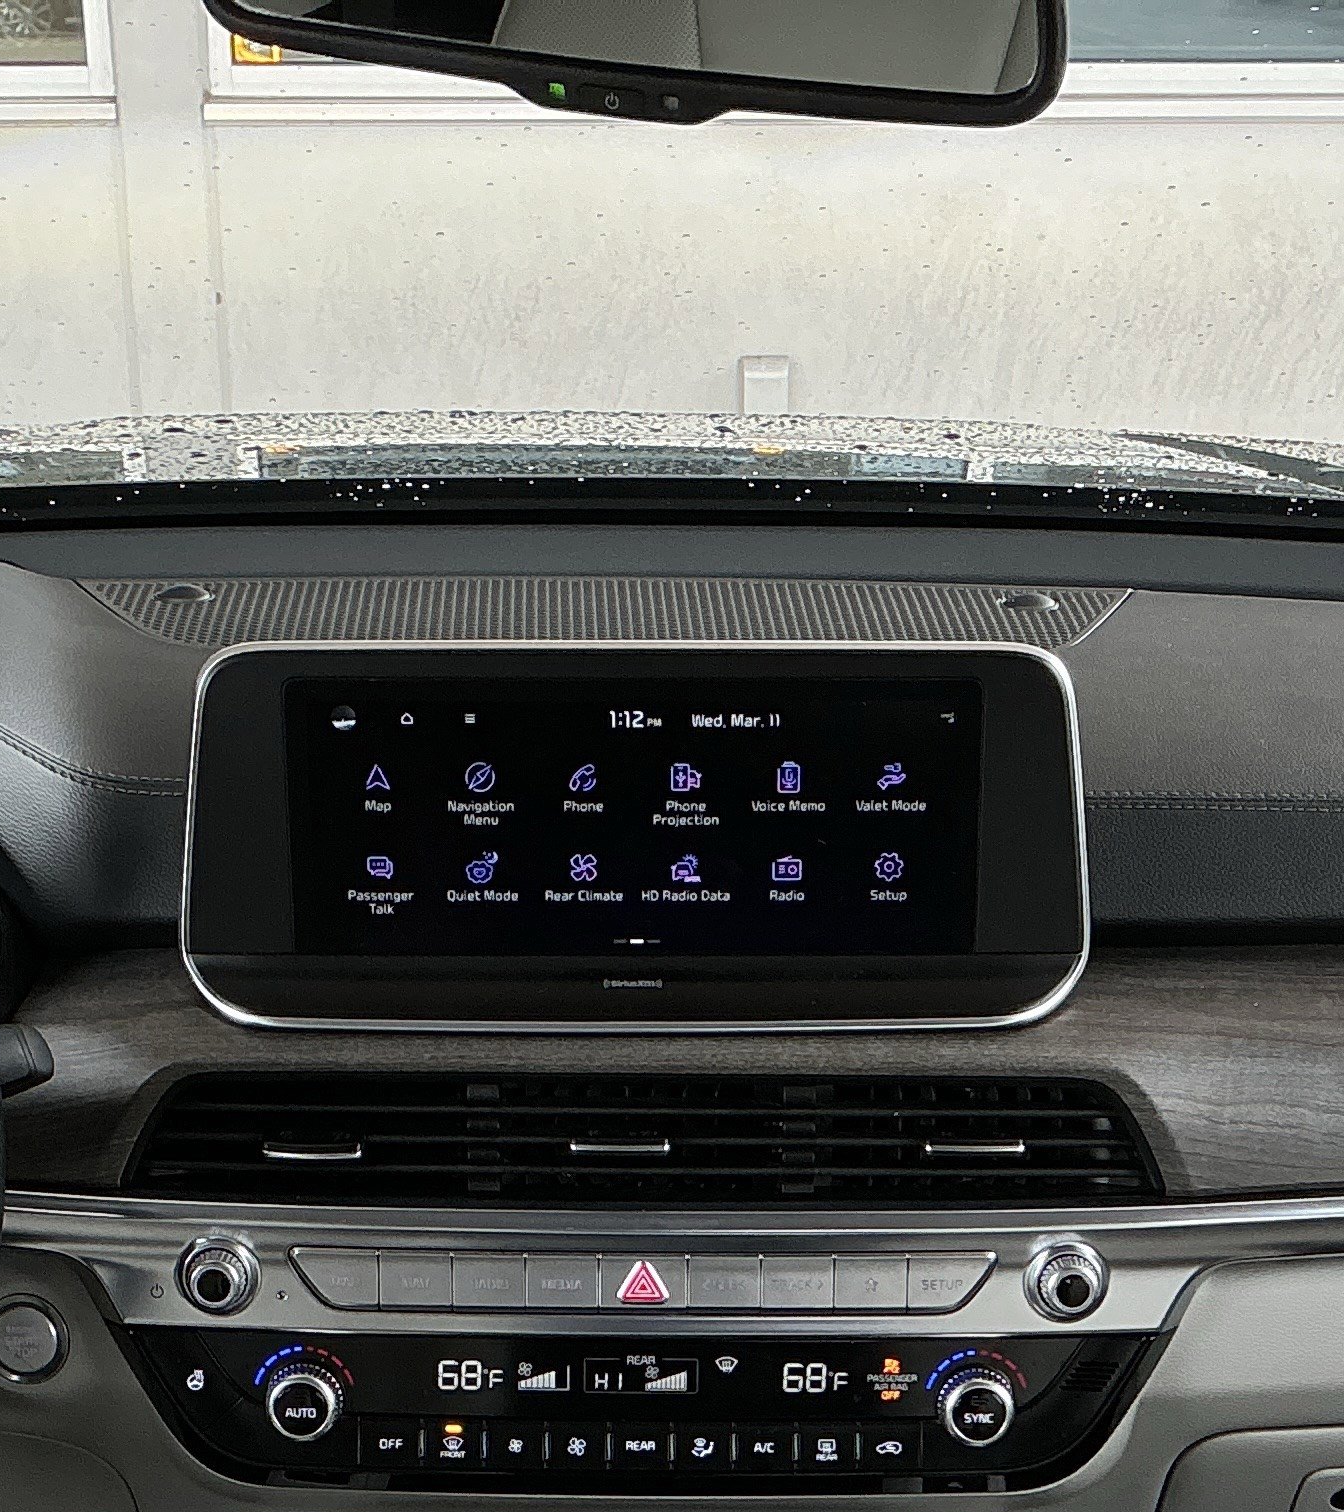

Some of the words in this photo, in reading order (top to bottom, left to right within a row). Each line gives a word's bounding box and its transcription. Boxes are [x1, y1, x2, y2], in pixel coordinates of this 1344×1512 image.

[609, 710, 644, 729] 1:12
[691, 713, 727, 728] Wed.
[731, 713, 764, 728] Mar.
[768, 713, 781, 728] 11
[364, 800, 393, 813] Map
[447, 800, 515, 814] Navigation
[563, 800, 605, 812] Phone
[665, 800, 707, 812] Phone
[751, 800, 786, 812] Voice
[789, 800, 826, 812] Memo
[855, 800, 889, 811] Valet
[891, 800, 927, 812] Mode
[463, 814, 500, 825] Menu
[652, 813, 720, 826] Projection
[347, 889, 415, 903] Passenger
[446, 889, 482, 902] Quiet
[484, 889, 519, 902] Mode
[544, 889, 575, 901] Rear
[577, 889, 624, 901] Climate
[641, 889, 659, 901] HD
[662, 889, 698, 901] Radio
[700, 889, 731, 901] Data
[769, 889, 805, 901] Radio
[869, 889, 908, 902] Setup
[368, 903, 395, 915] Talk
[920, 1278, 964, 1291] SETUP
[626, 1355, 656, 1366] REAR
[866, 1373, 918, 1383] PASSENGER
[880, 1390, 901, 1400] OFF
[284, 1407, 317, 1419] AUTO
[963, 1412, 995, 1424] SYNC
[378, 1438, 404, 1450] OFF
[625, 1440, 656, 1451] REAR
[753, 1441, 775, 1453] A/C
[439, 1449, 466, 1459] FRONT
[815, 1452, 838, 1461] REAR
